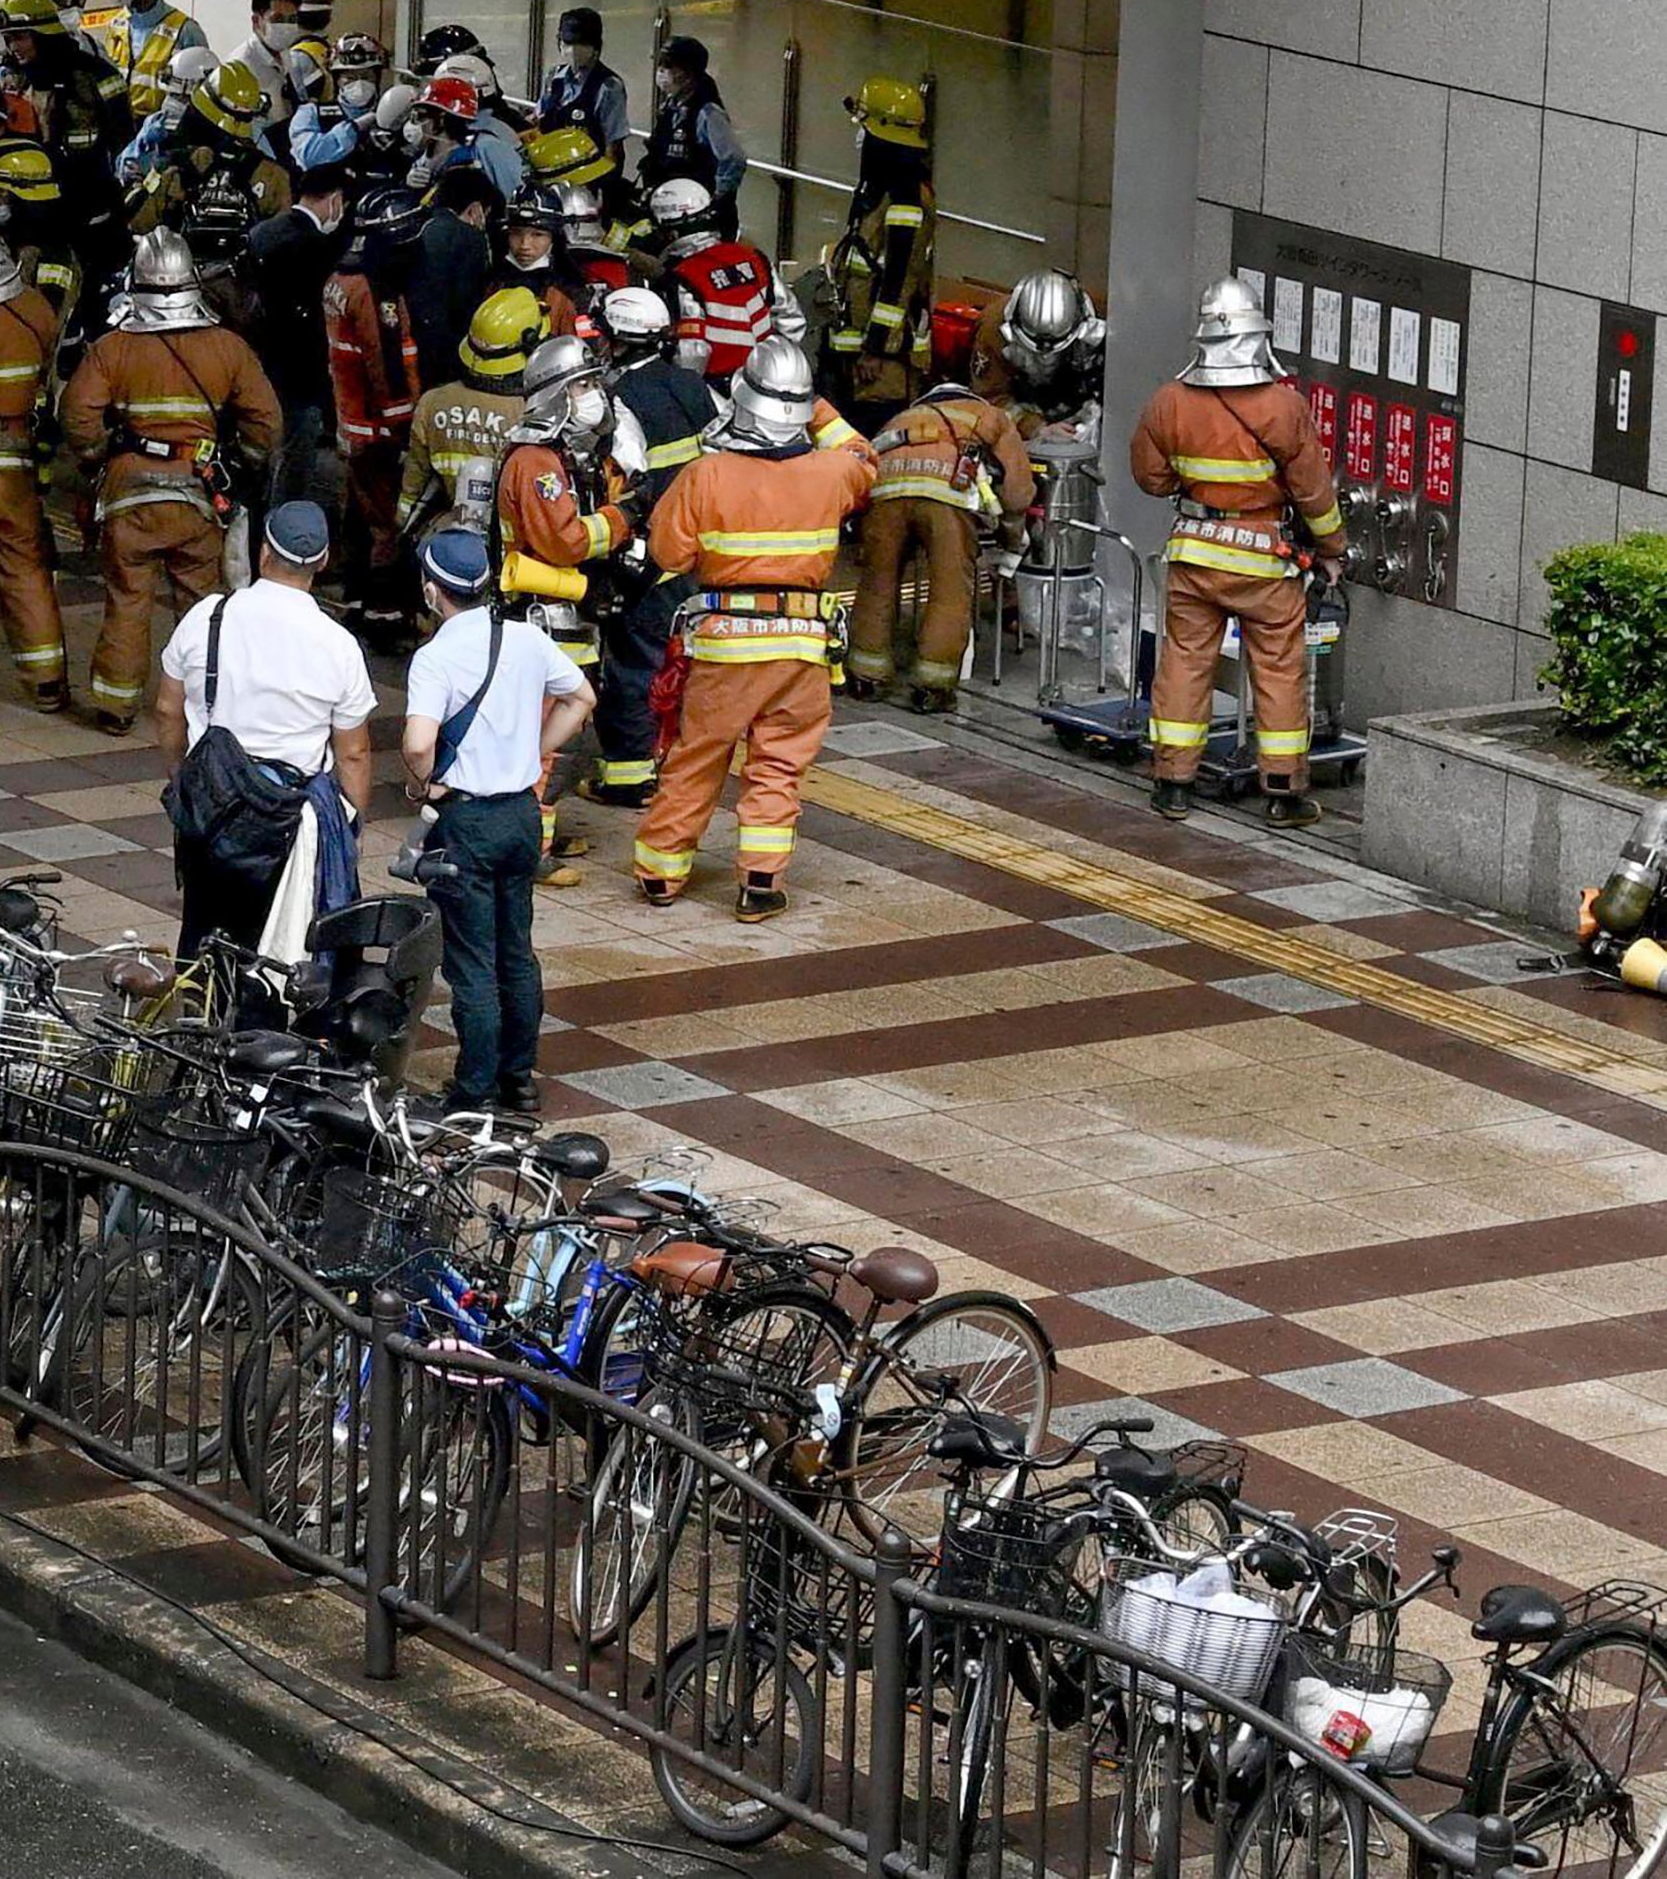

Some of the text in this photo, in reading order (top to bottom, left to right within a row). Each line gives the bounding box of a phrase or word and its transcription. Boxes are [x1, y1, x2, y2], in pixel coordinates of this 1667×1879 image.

[434, 405, 518, 438] OSAK
[1173, 519, 1272, 549] 大阪市消防局
[713, 617, 826, 634] 大阪市消防局
